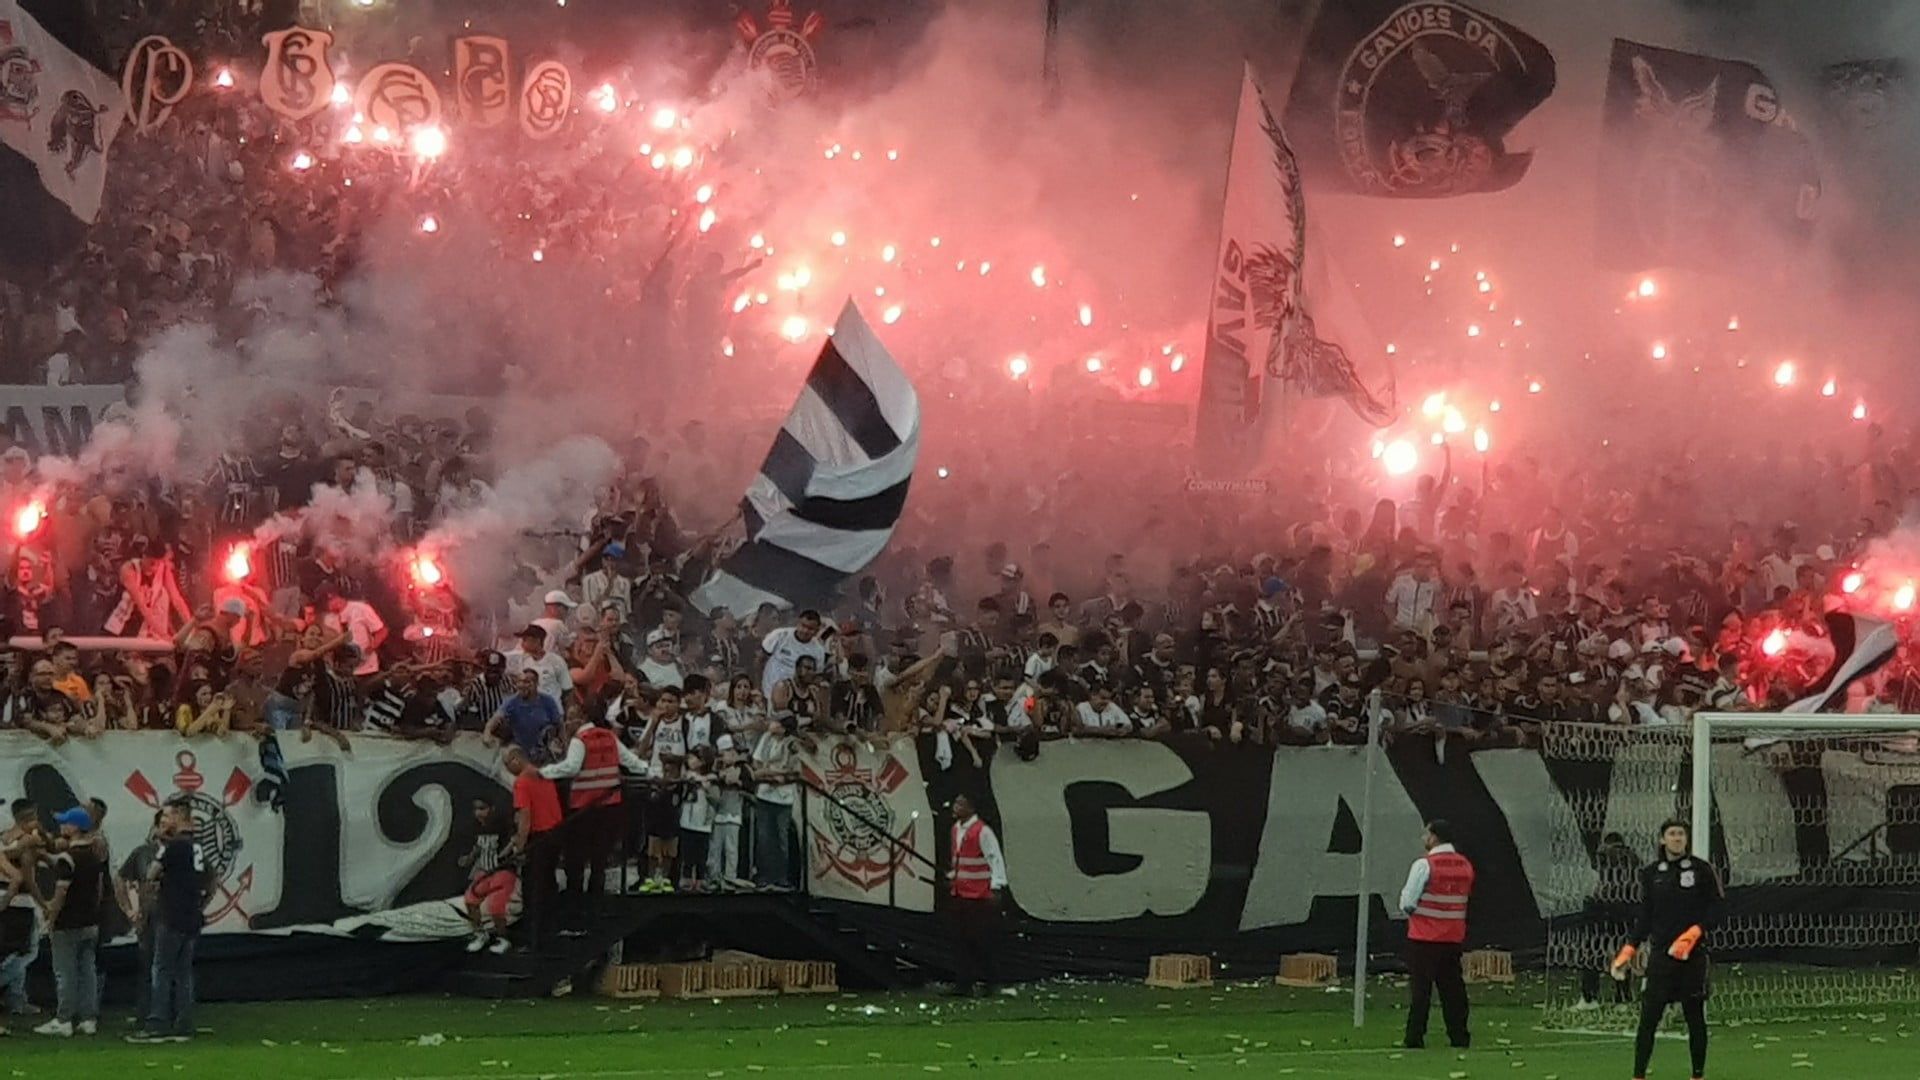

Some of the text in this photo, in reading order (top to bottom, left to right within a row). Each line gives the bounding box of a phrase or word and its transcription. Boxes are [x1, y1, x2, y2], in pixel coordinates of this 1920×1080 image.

[1360, 7, 1498, 69] GAVIÕES DA
[250, 762, 516, 929] 12
